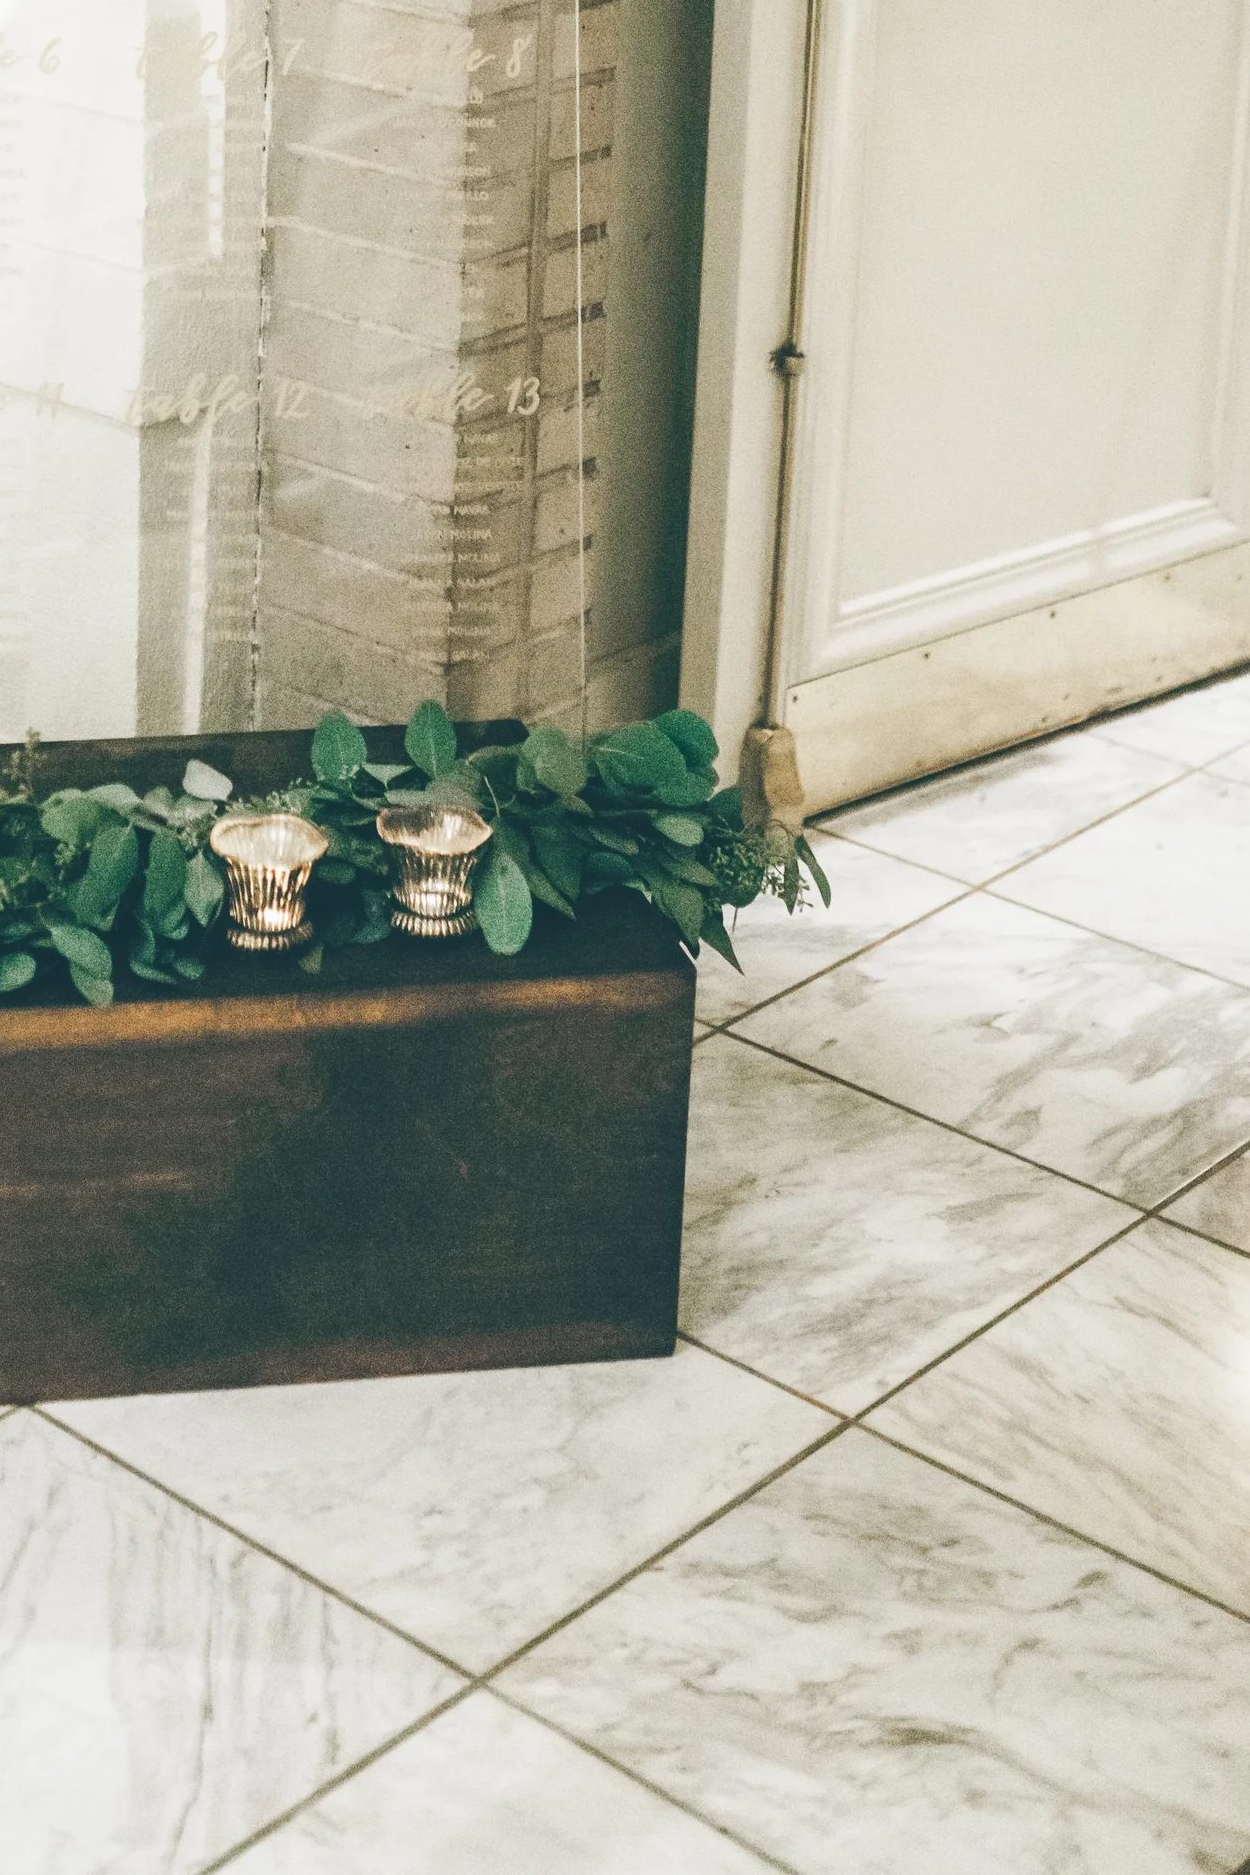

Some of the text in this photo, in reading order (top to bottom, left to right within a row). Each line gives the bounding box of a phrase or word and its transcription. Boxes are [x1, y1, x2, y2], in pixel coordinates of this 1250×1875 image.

[39, 36, 62, 75] 6
[132, 30, 272, 81] tble
[281, 37, 306, 76] 7
[506, 33, 532, 79] 8
[127, 372, 311, 427] table 12
[504, 376, 541, 416] 13
